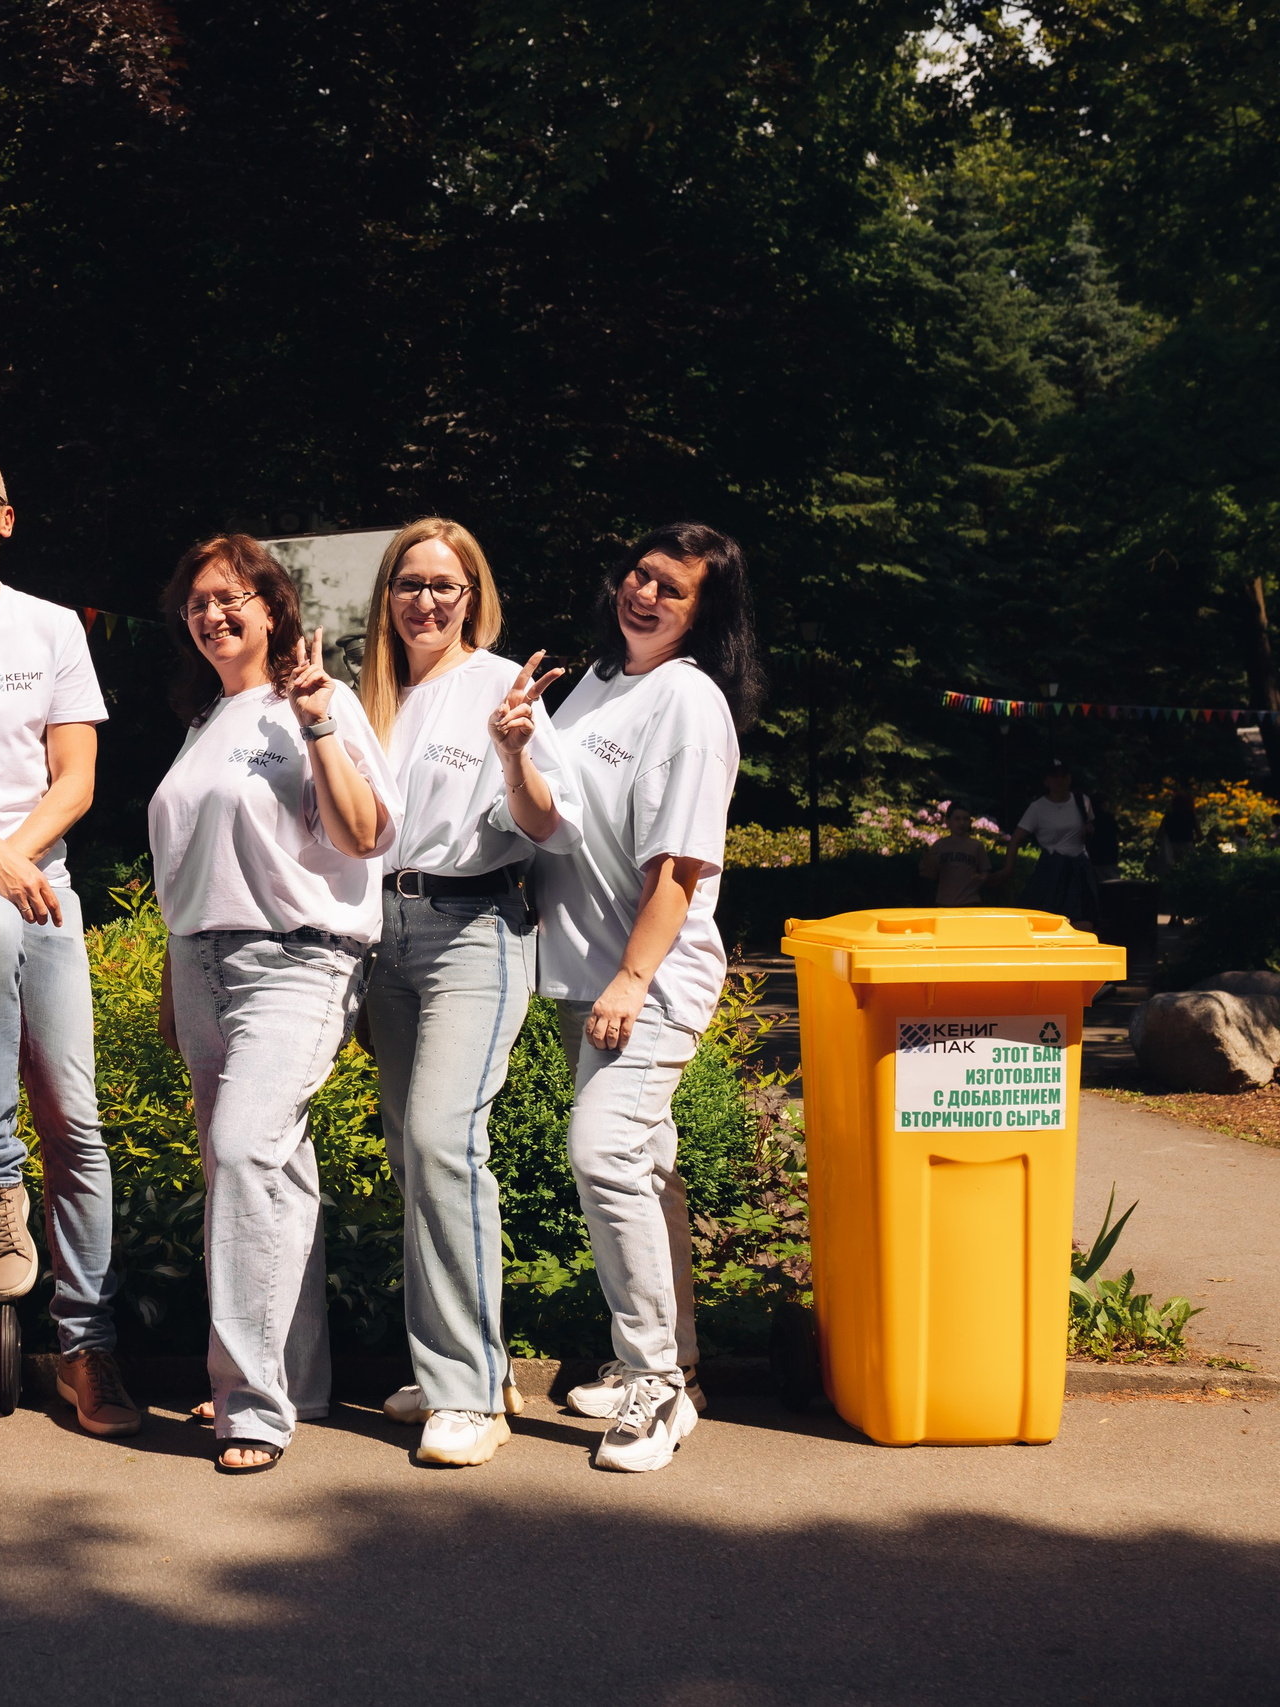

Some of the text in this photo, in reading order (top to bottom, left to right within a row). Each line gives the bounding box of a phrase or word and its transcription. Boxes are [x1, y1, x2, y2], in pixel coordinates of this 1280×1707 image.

[5, 672, 43, 682] КЕНИГ
[6, 682, 33, 691] ПАК
[243, 756, 269, 768] ПАК
[249, 748, 288, 763] КЕНИГ
[440, 755, 467, 772] ПАК
[444, 746, 483, 767] КЕНИГ
[594, 747, 621, 768] ПАК
[933, 1023, 998, 1037] КЕНИГ
[934, 1041, 976, 1053] ПАК
[992, 1046, 1062, 1063] ЭТОТ БАК
[966, 1067, 1061, 1085] ИЗГОТОВЛЕН
[934, 1088, 1061, 1108] С ДОБАВЛЕНИЕМ
[901, 1109, 1061, 1127] ВТОРИЧНОГО СЫРЬЯ
